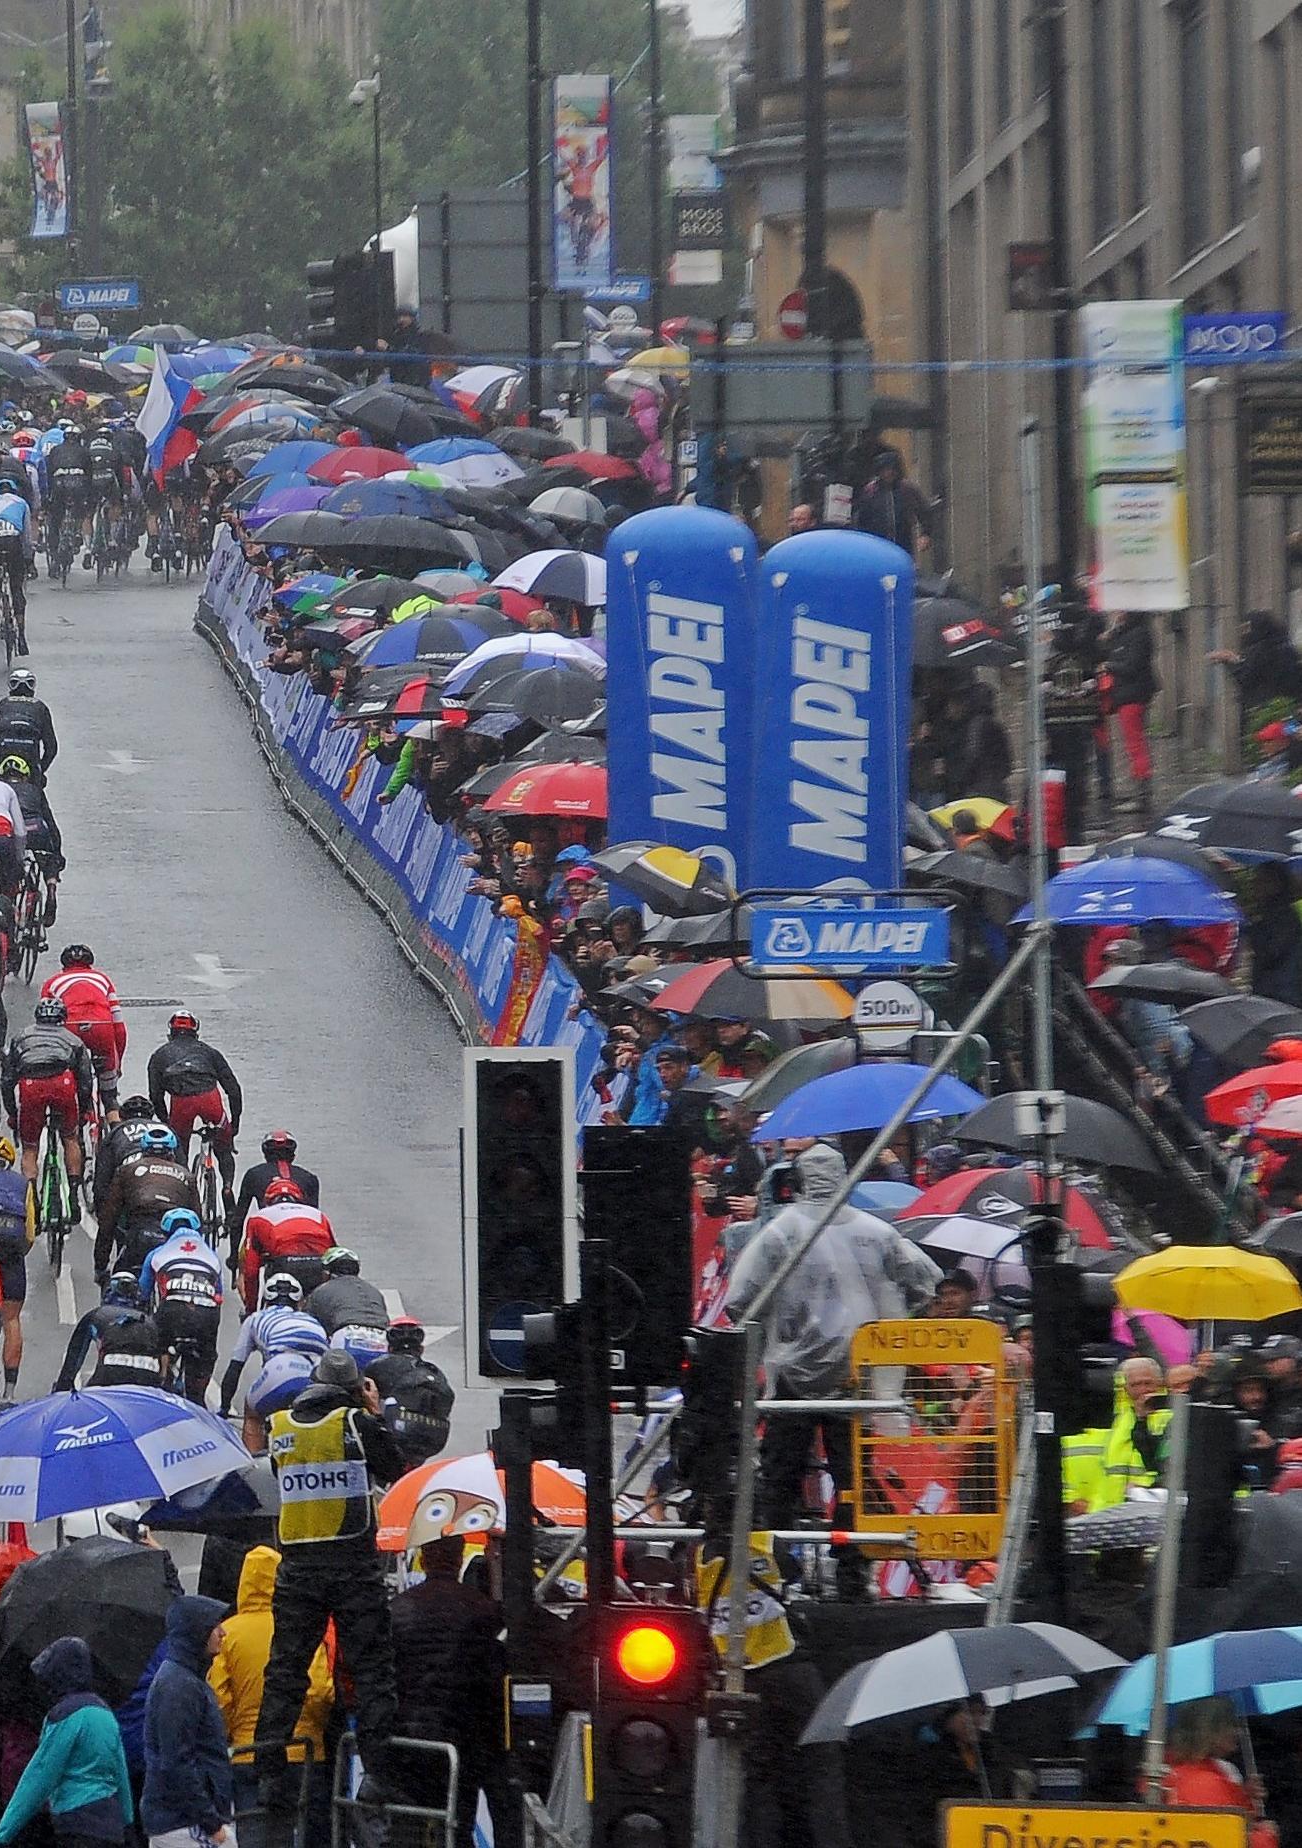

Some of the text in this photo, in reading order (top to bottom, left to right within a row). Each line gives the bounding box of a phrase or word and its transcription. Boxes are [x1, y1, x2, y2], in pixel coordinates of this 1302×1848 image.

[680, 208, 724, 221] MOSS
[679, 221, 724, 237] BROS
[86, 288, 130, 304] MAPEI
[647, 593, 728, 831] MAPEI
[788, 616, 872, 863] MAPEI
[816, 922, 929, 954] MAPEI
